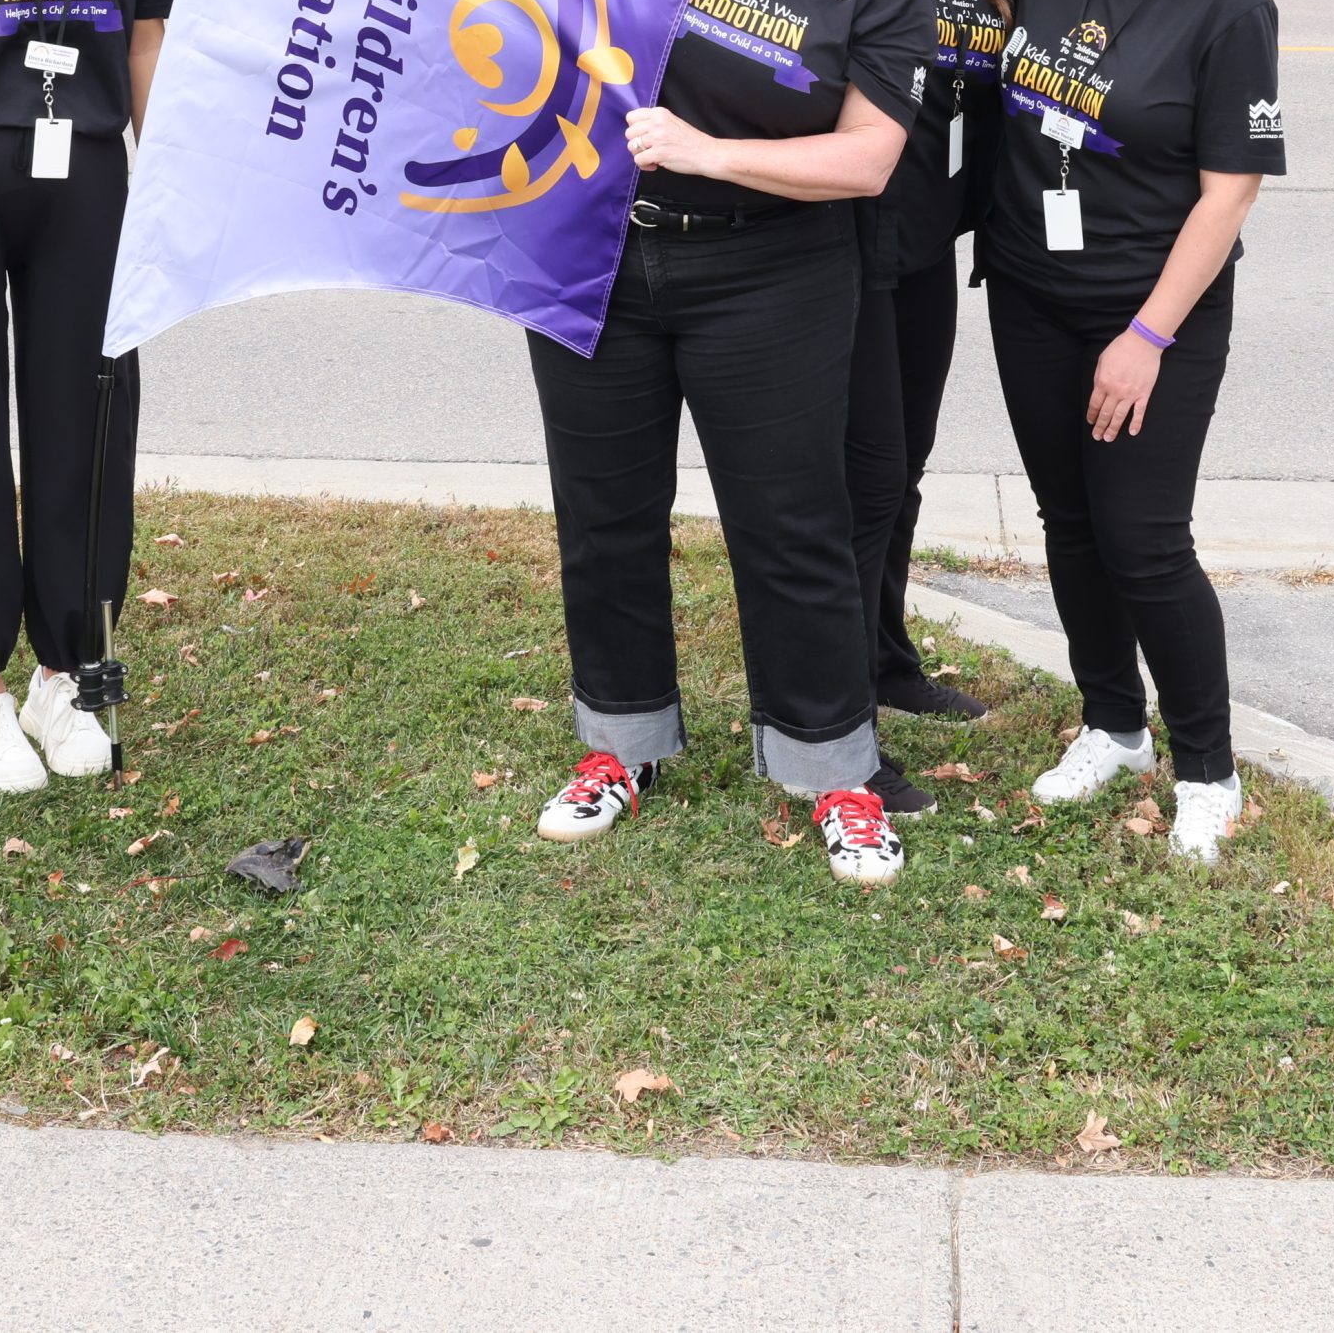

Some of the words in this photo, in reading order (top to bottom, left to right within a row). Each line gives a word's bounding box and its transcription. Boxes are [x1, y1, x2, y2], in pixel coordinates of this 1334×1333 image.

[5, 8, 30, 20] Helping
[71, 5, 80, 14] at
[90, 6, 107, 14] Time
[774, 2, 809, 28] Wait
[711, 25, 727, 39] One
[729, 33, 752, 49] Child
[752, 44, 764, 55] at
[773, 51, 793, 66] Time
[1023, 43, 1051, 65] Kids
[965, 57, 974, 66] at
[982, 60, 996, 69] Time
[1011, 90, 1035, 110] Helping
[1249, 119, 1281, 128] WILKI
